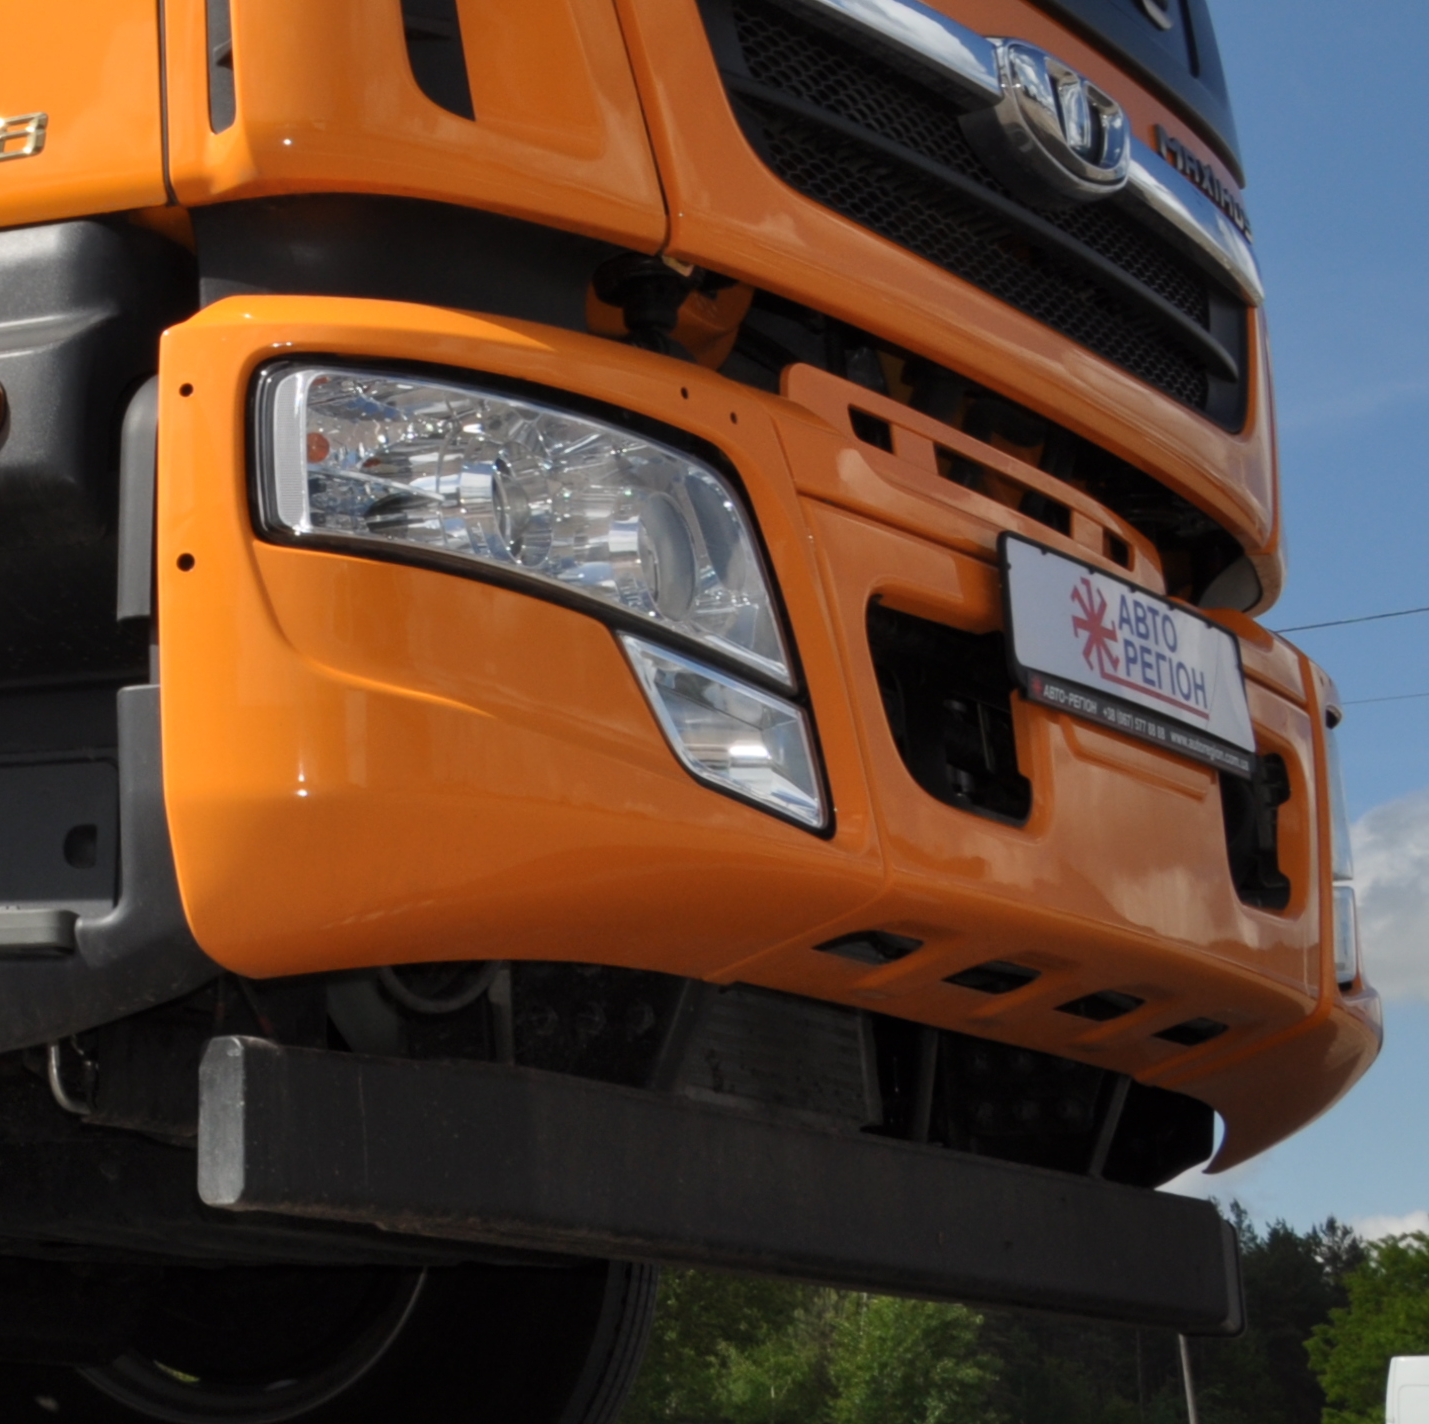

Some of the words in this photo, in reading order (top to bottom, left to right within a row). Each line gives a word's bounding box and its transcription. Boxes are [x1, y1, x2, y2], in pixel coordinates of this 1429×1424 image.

[1118, 594, 1178, 653] АВТО
[1043, 684, 1098, 714] АВТО-РЕГІОН
[1123, 638, 1208, 709] РЕГІОН
